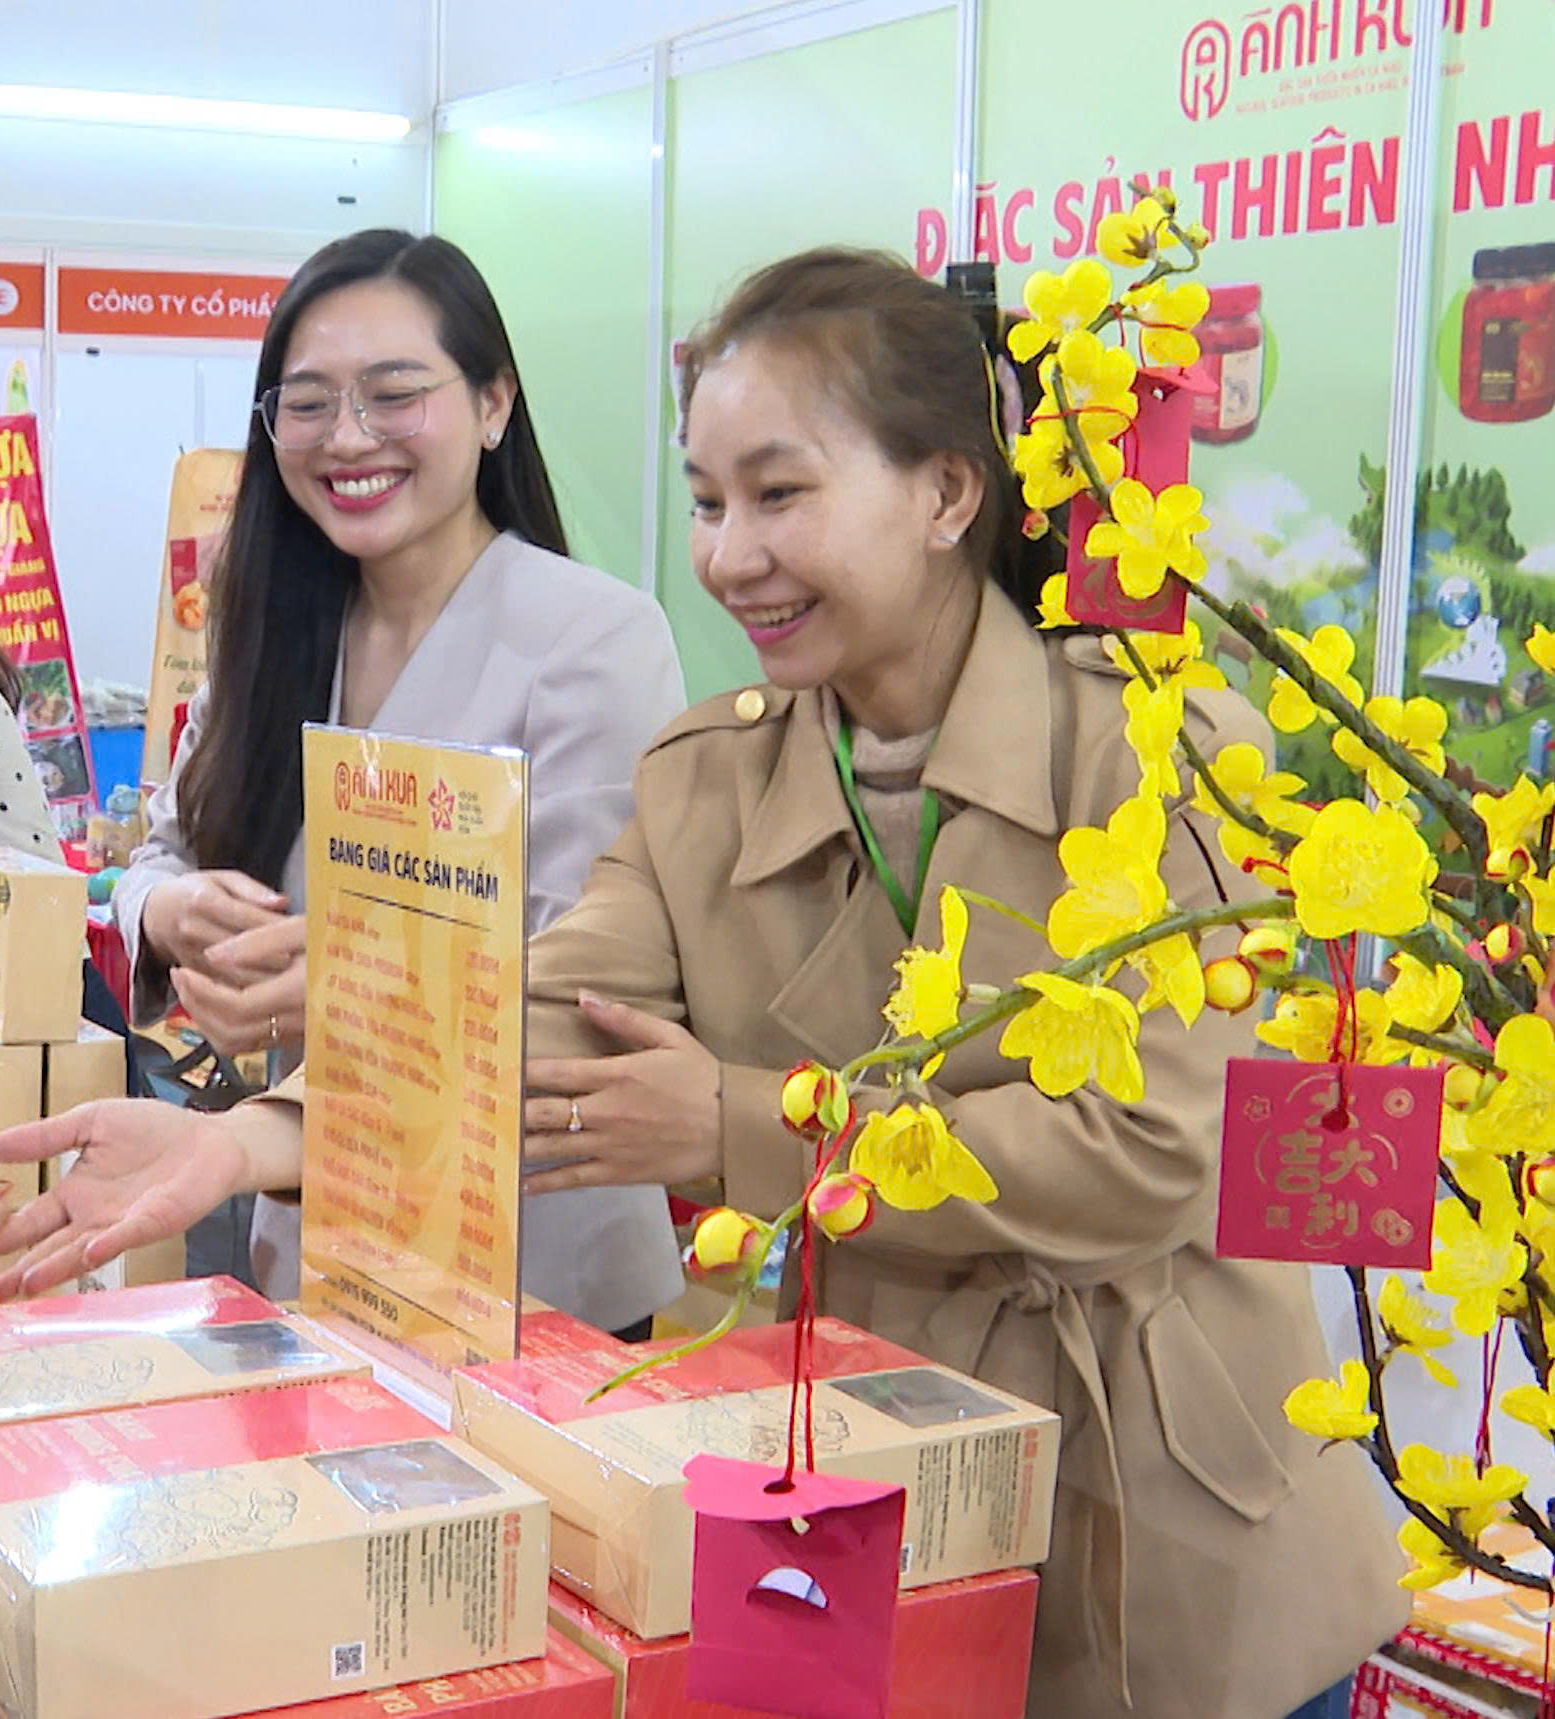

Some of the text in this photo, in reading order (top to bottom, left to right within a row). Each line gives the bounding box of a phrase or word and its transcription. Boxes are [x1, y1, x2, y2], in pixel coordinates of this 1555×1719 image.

[1194, 127, 1401, 244] THIÊN
[87, 288, 155, 315] CÔNG
[158, 294, 188, 315] TY
[367, 844, 391, 876] GIÁ
[394, 850, 420, 883] CÁC
